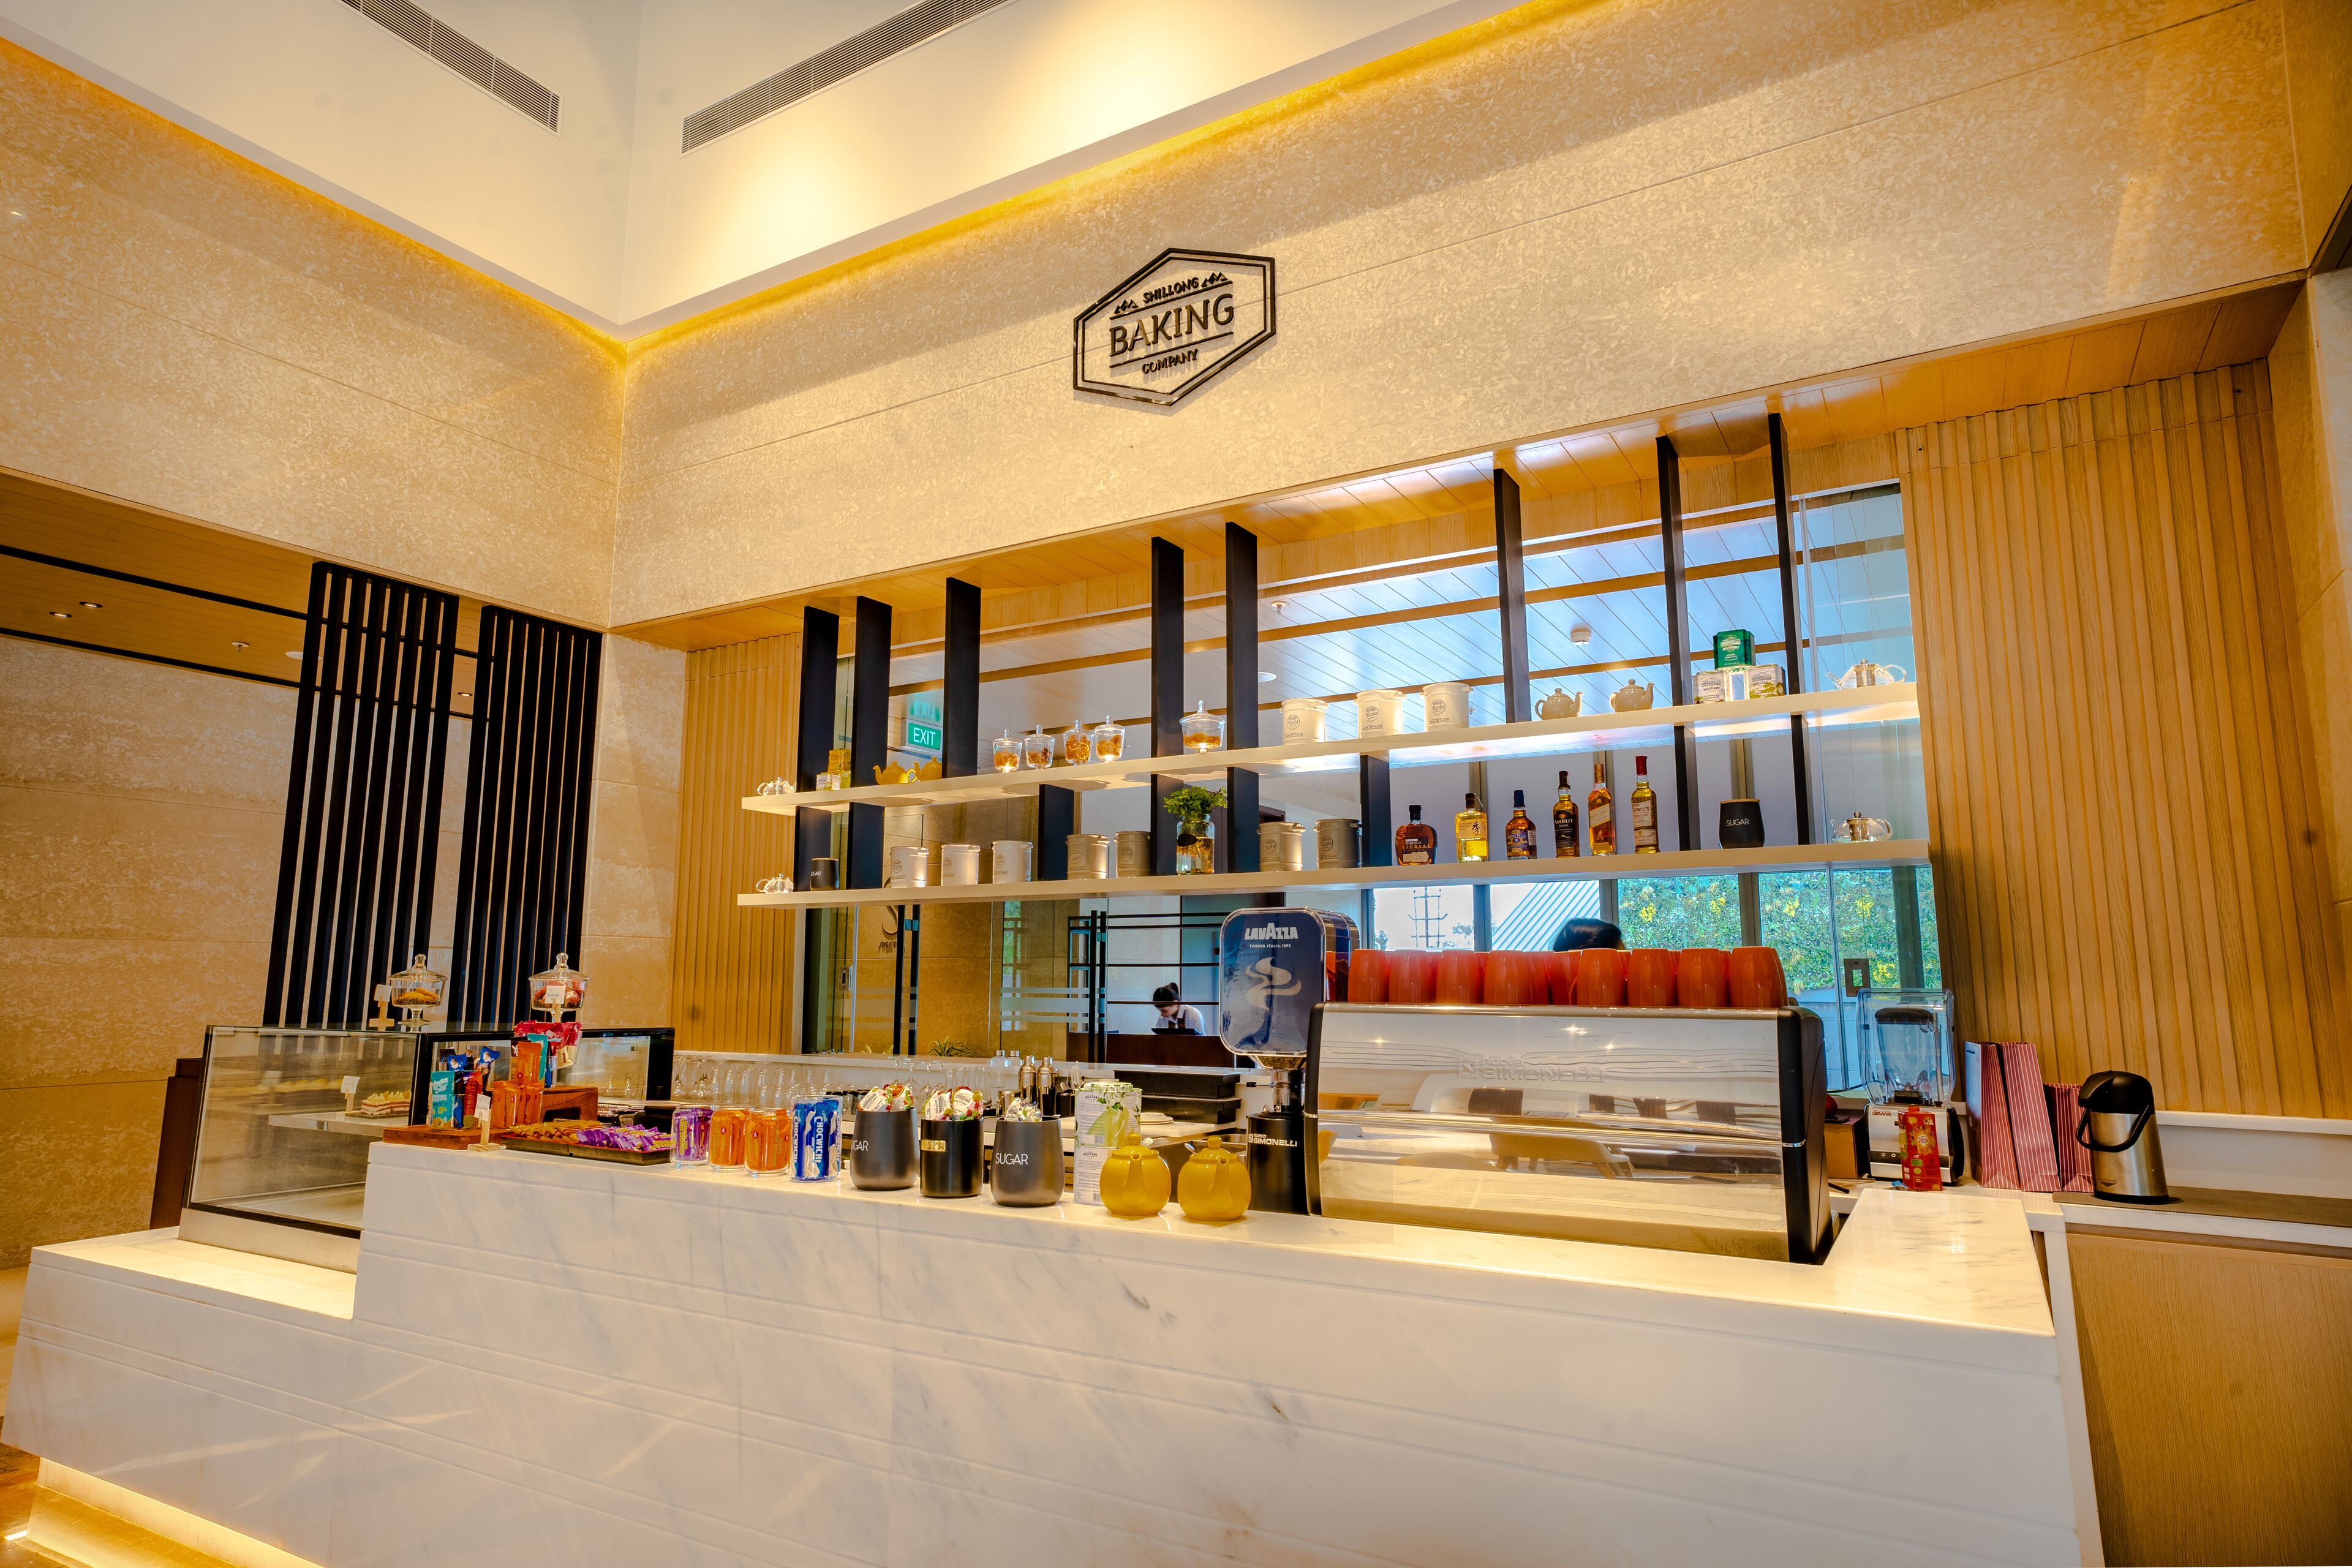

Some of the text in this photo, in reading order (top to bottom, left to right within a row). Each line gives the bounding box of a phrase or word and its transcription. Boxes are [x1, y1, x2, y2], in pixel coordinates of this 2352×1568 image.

[1142, 277, 1200, 304] SHILLONG
[1109, 293, 1234, 357] BAKING
[1142, 348, 1199, 374] COMPANY
[914, 727, 936, 746] EXIT
[1726, 818, 1749, 826] SUGAR
[1244, 923, 1298, 940] LAVAZZA
[1482, 1066, 1605, 1083] SIMONELLI
[1253, 1138, 1298, 1147] SIMONELLI
[995, 1152, 1028, 1165] SUGAR
